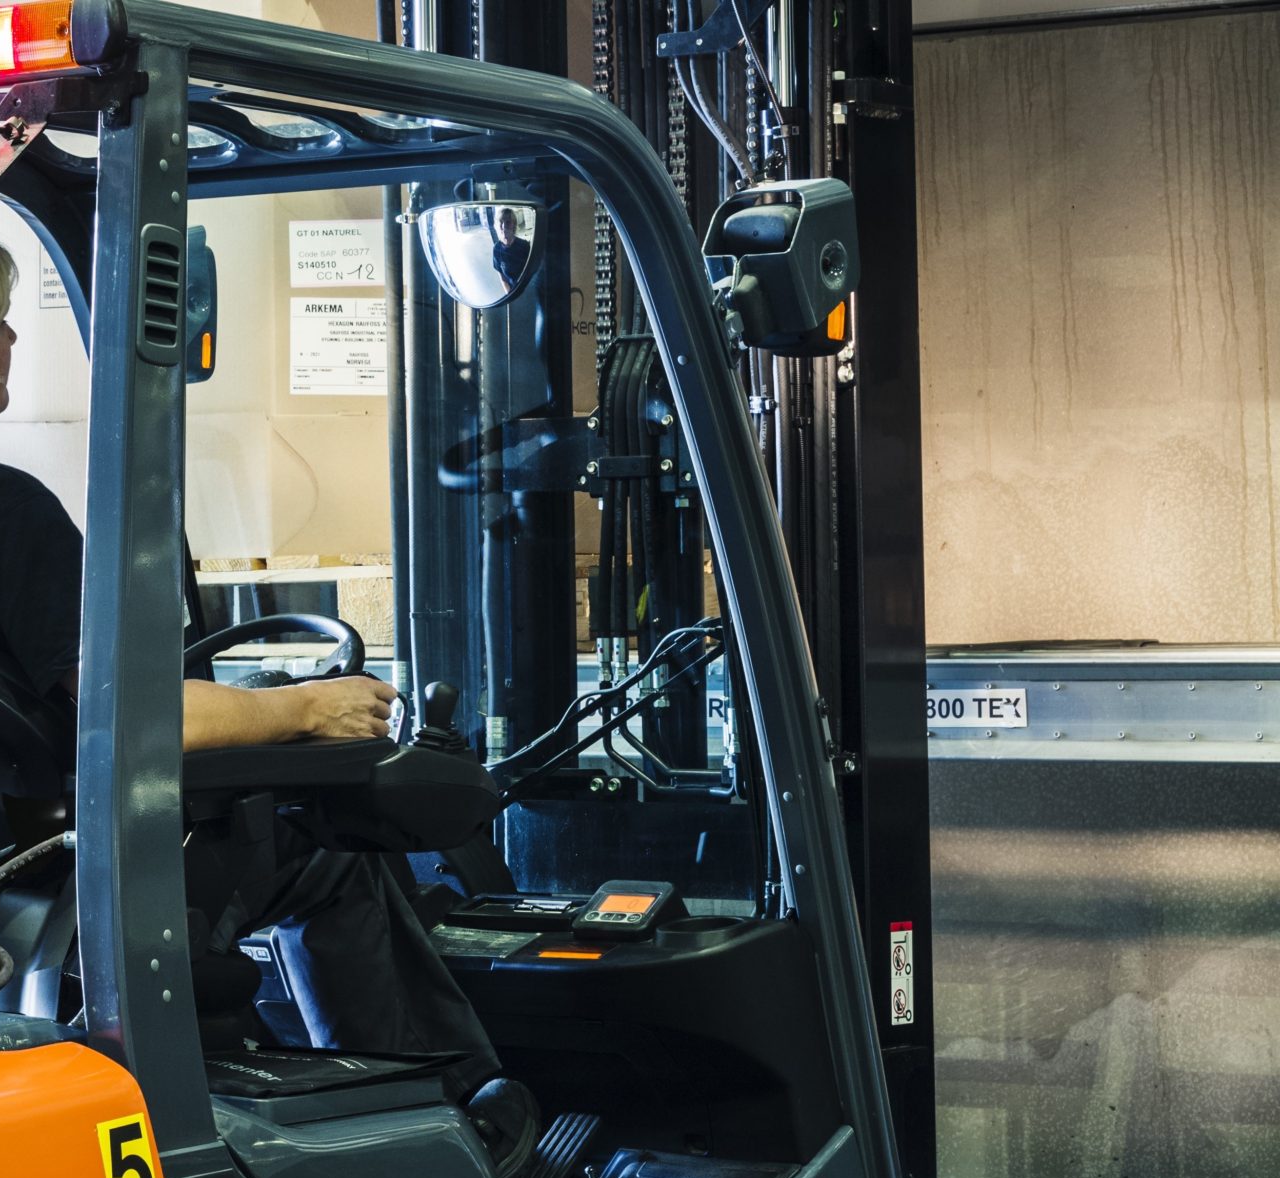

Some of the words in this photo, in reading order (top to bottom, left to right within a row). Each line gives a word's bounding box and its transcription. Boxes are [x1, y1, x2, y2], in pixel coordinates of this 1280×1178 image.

[297, 229, 308, 237] GT
[342, 248, 370, 256] 60377
[297, 261, 337, 269] S140510
[316, 272, 333, 280] CC
[336, 272, 344, 280] N
[347, 263, 375, 280] 12
[305, 304, 344, 313] ARKEMA
[708, 698, 724, 718] R
[972, 698, 1021, 719] TEX
